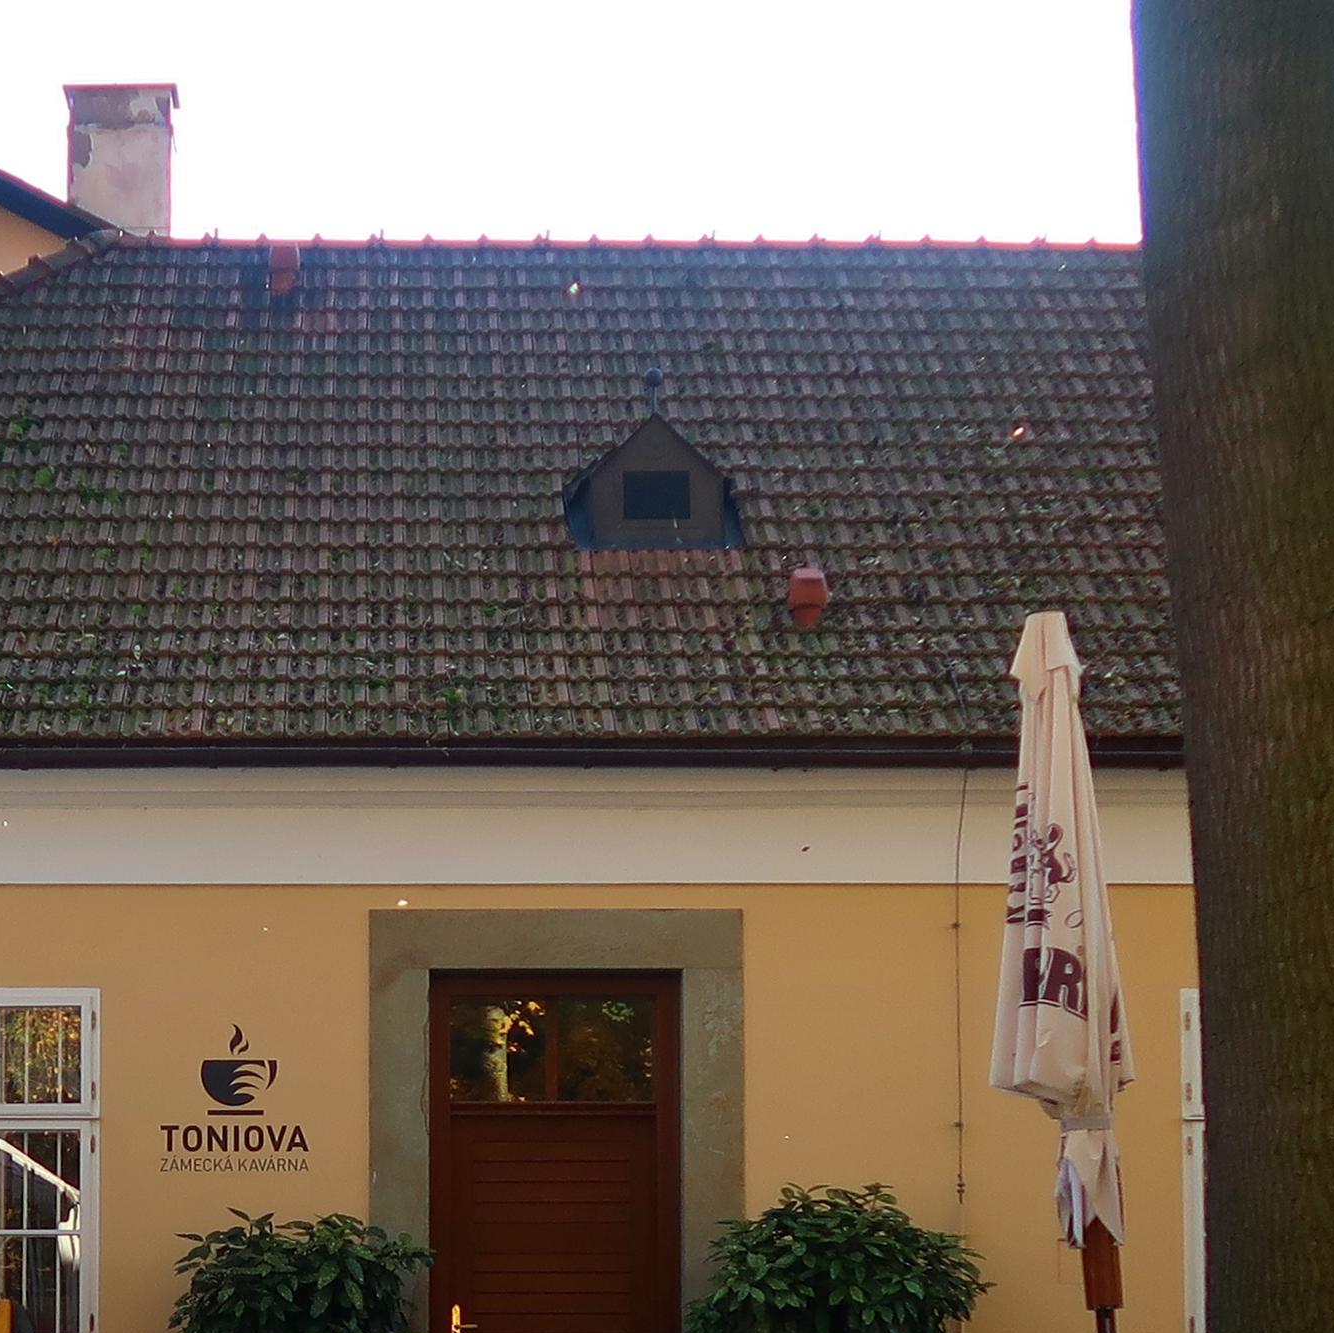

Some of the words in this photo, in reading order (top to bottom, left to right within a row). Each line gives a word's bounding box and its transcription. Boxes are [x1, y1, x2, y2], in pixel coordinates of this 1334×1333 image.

[160, 1125, 309, 1152] TONIOVA
[160, 1155, 234, 1172] ZÁMECKÁ
[238, 1155, 309, 1172] KAVÁRNA
